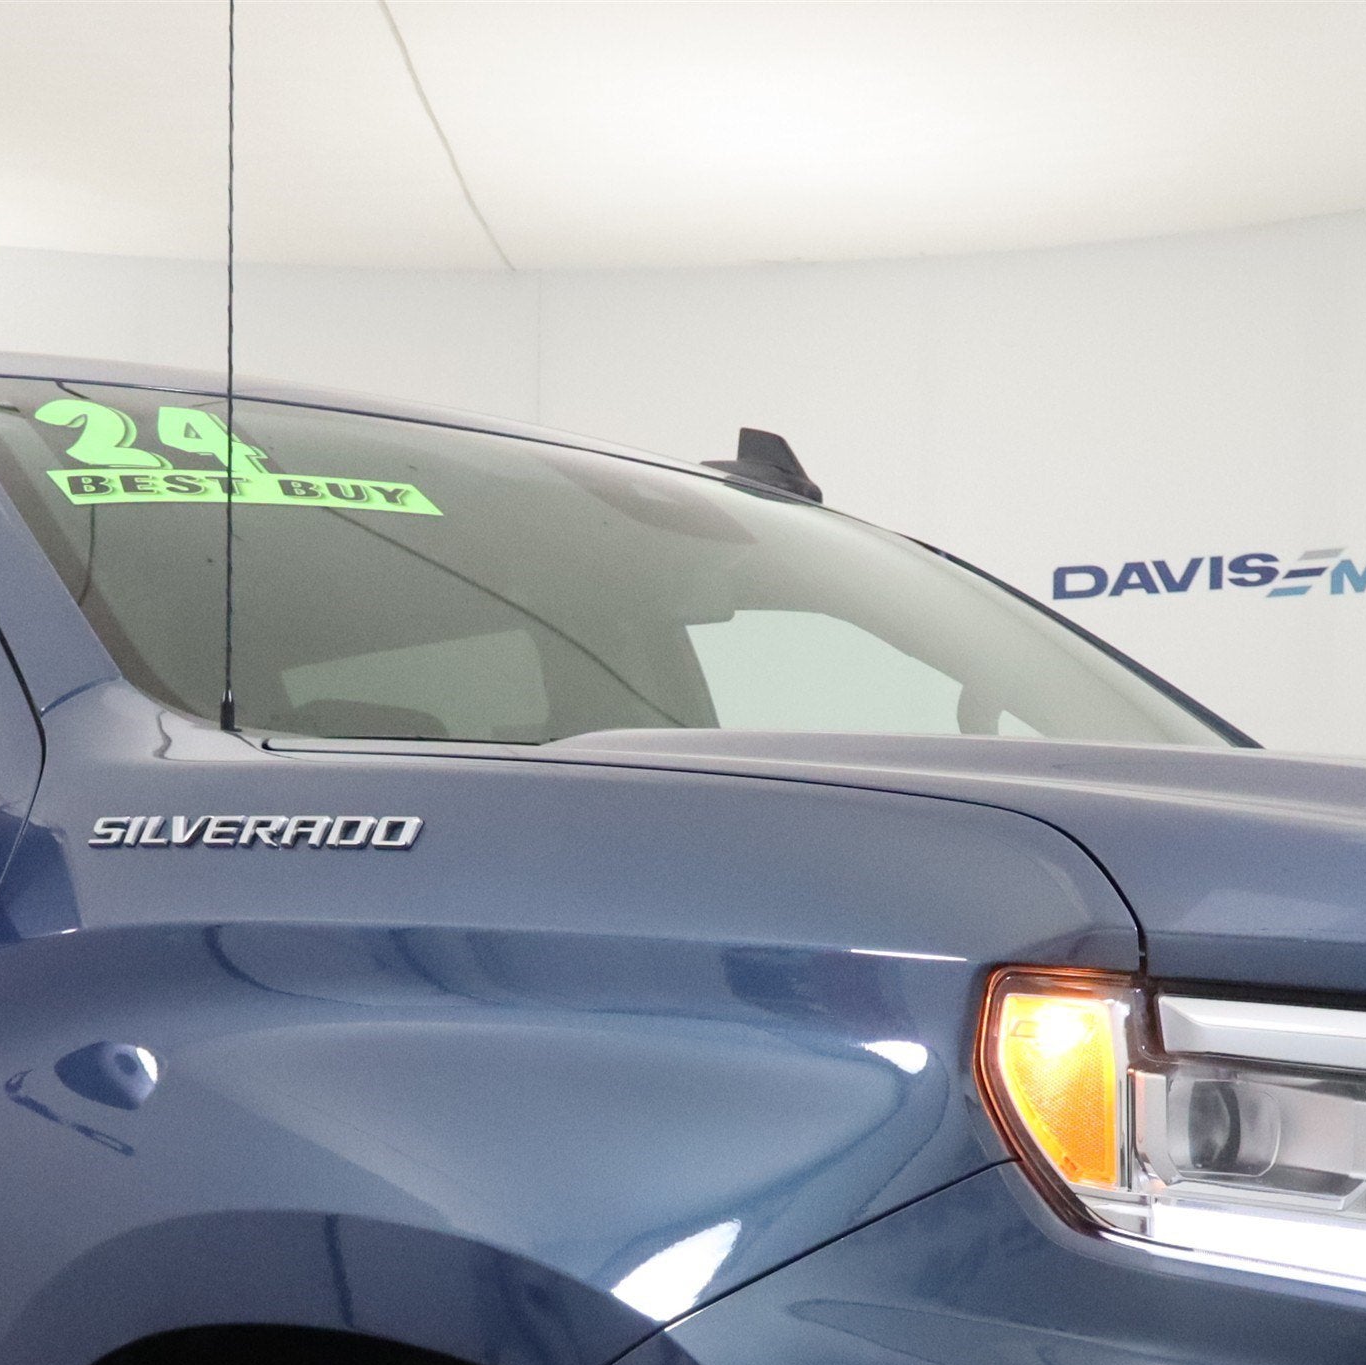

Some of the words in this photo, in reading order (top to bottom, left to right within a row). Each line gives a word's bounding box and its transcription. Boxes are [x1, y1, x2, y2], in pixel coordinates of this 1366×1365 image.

[35, 398, 271, 474] 24
[66, 472, 248, 497] BEST
[279, 478, 410, 506] BUY
[1052, 552, 1281, 600] DAVIS
[88, 815, 425, 850] SILVERADO
